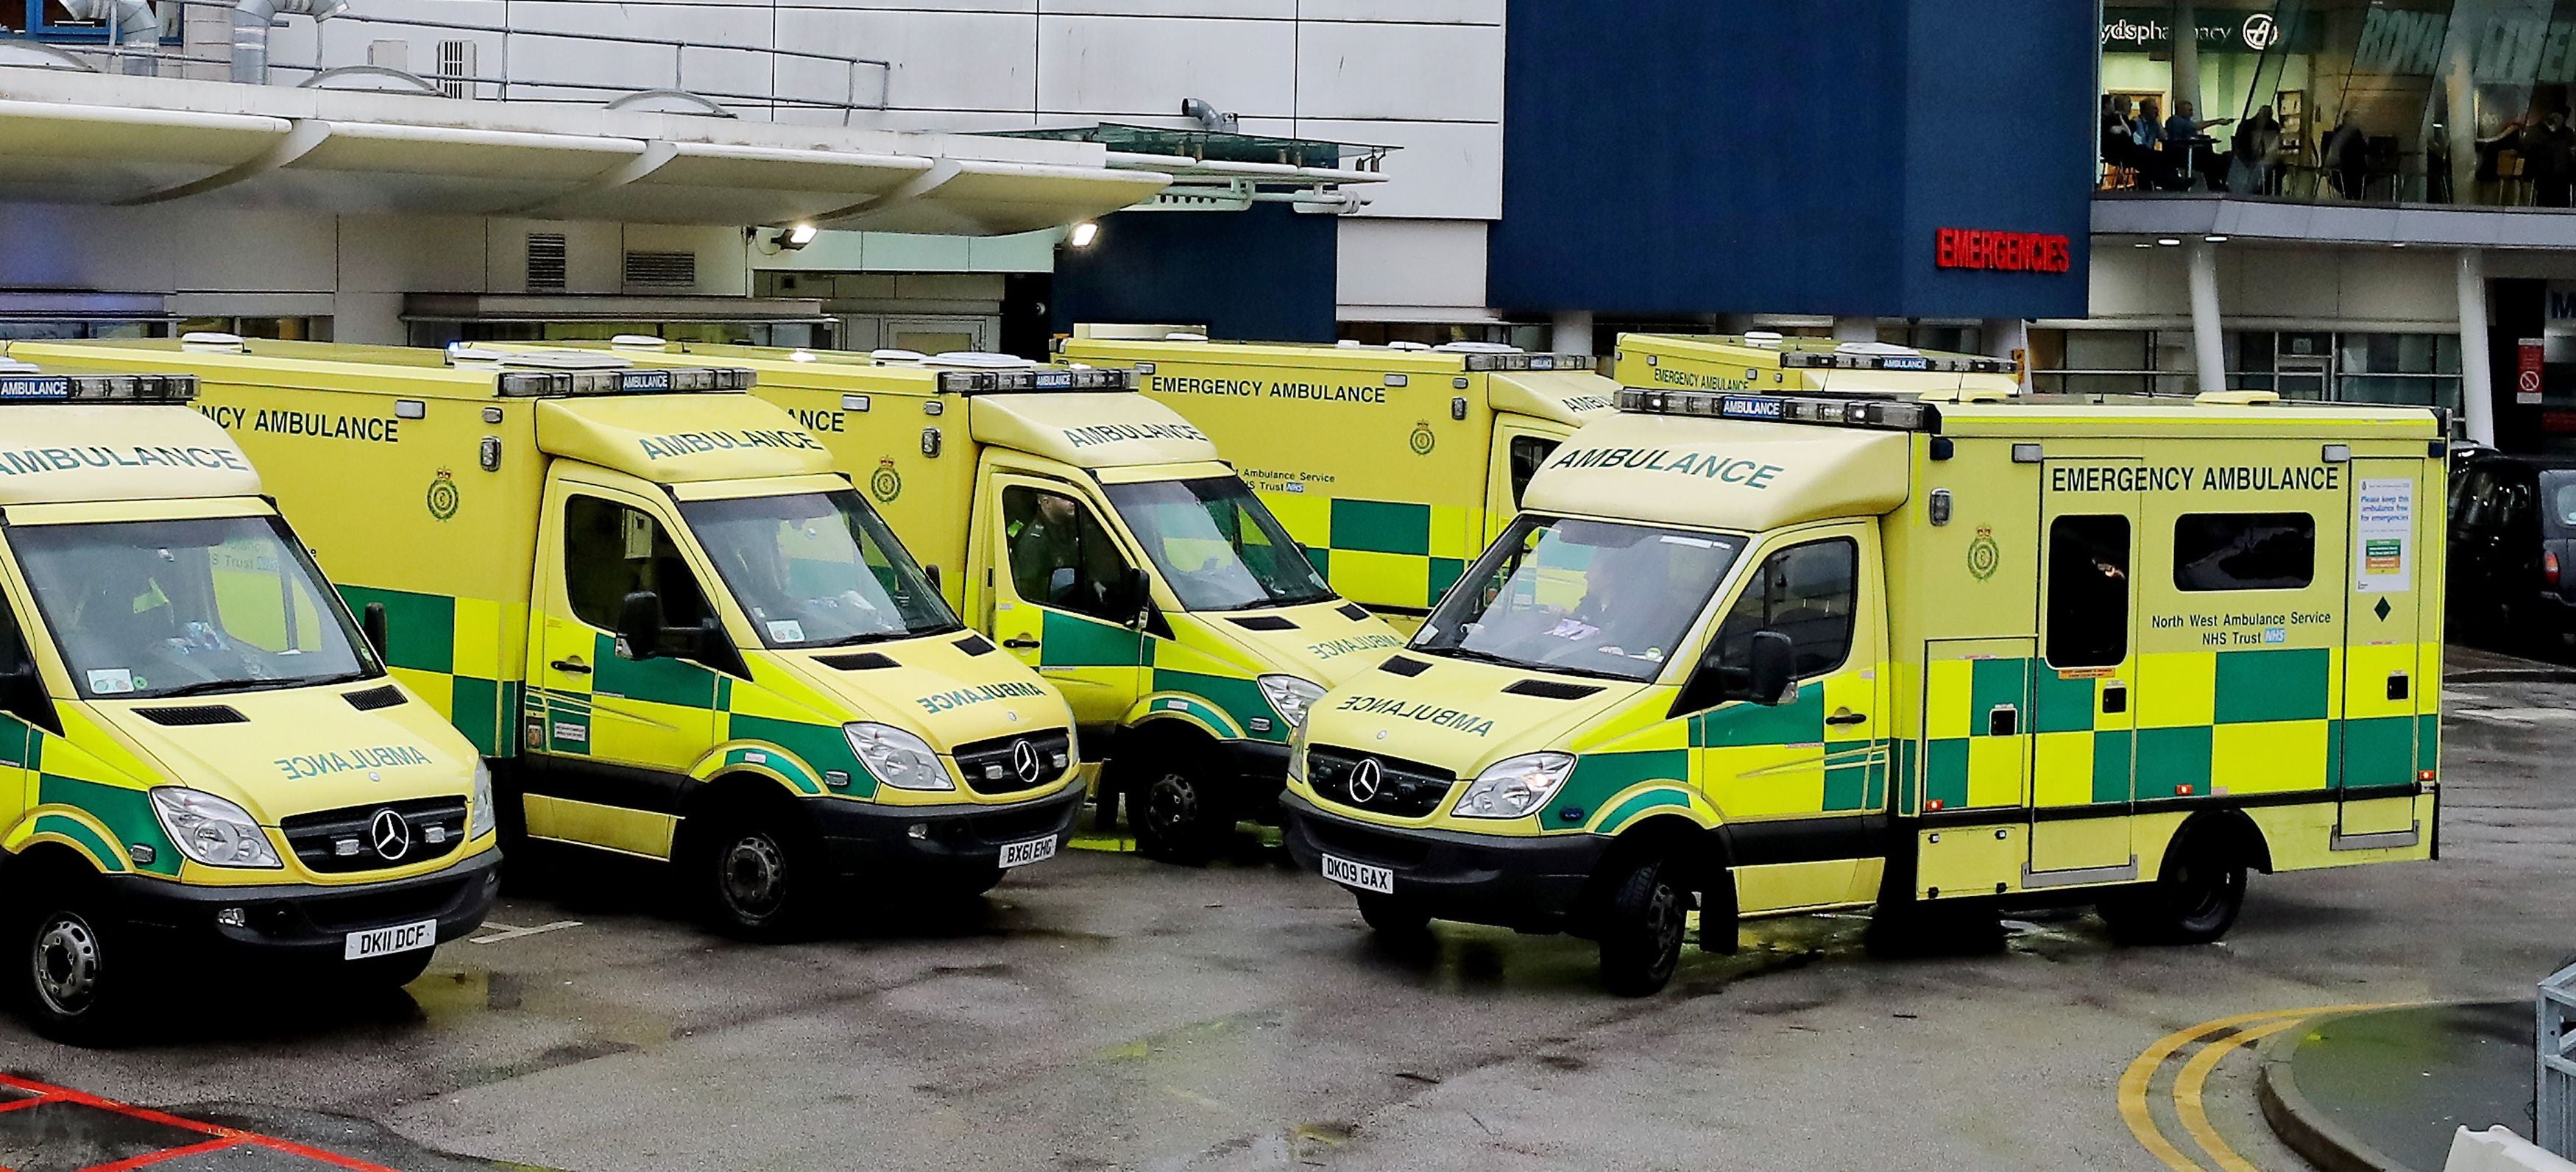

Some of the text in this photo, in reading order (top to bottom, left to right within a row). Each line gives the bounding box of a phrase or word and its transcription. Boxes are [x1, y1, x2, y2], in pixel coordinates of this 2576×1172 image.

[2354, 8, 2449, 74] ROYA
[1936, 228, 2070, 272] EMERGENCIES
[1883, 358, 1927, 369] AMBULANCE
[1, 381, 68, 395] AMBULANCE
[623, 375, 668, 388] AMBULANCE
[1036, 374, 1071, 386] AMBULANCE
[1152, 376, 1386, 403] EMERGENCY AMBULANCE
[1655, 368, 1749, 391] EMERGENCY AMBULANCE
[1723, 400, 1780, 416] AMBULANCE
[255, 409, 398, 442] AMBULANCE
[1063, 424, 1209, 447] AMBULANCE
[639, 430, 824, 461] AMBULANCE
[1243, 469, 1295, 480] Ambulance
[1300, 472, 1335, 483] Service
[1549, 448, 1785, 489] AMBULANCE
[2052, 466, 2338, 491] EMERGENCY AMBULANCE
[1260, 482, 1284, 491] Trust
[1287, 483, 1303, 492] NHS
[2382, 496, 2396, 504] keep
[224, 555, 254, 570] Trust
[2152, 611, 2331, 628] North West Ambulance Service
[2202, 628, 2285, 645] NHS Trust NHS
[1007, 842, 1033, 863] BX61
[1327, 857, 1387, 889] DK09 GAX
[361, 925, 425, 954] DK11 DCF
